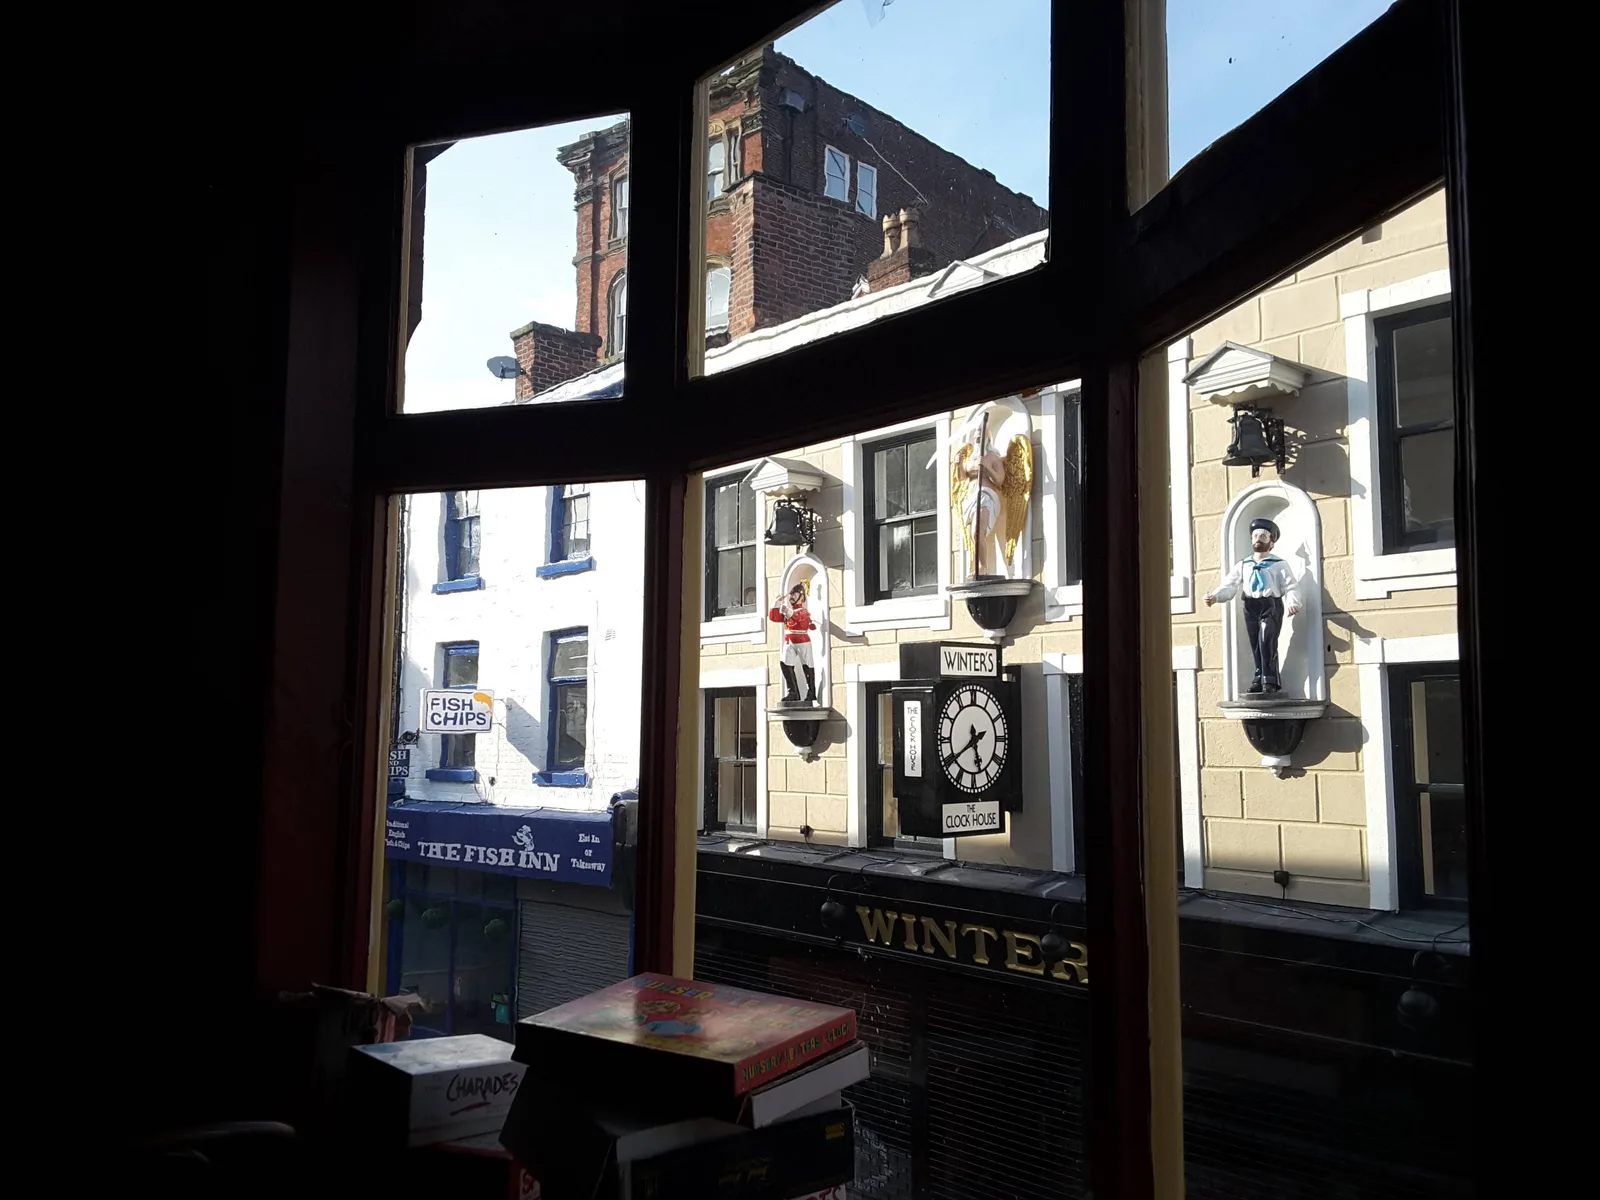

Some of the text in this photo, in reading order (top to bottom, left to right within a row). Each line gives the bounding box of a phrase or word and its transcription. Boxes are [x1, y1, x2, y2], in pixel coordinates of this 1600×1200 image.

[943, 650, 994, 672] WINTER'S
[430, 697, 473, 711] FISH
[907, 707, 918, 715] THE
[430, 712, 487, 726] CHIPS
[966, 804, 976, 813] THE
[946, 812, 997, 828] CLOCK HOUSE
[578, 833, 600, 844] Eat In
[417, 840, 561, 872] THE FISH INN
[584, 849, 593, 857] or
[570, 858, 606, 873] Takeaway
[446, 1072, 518, 1101] CHARADES
